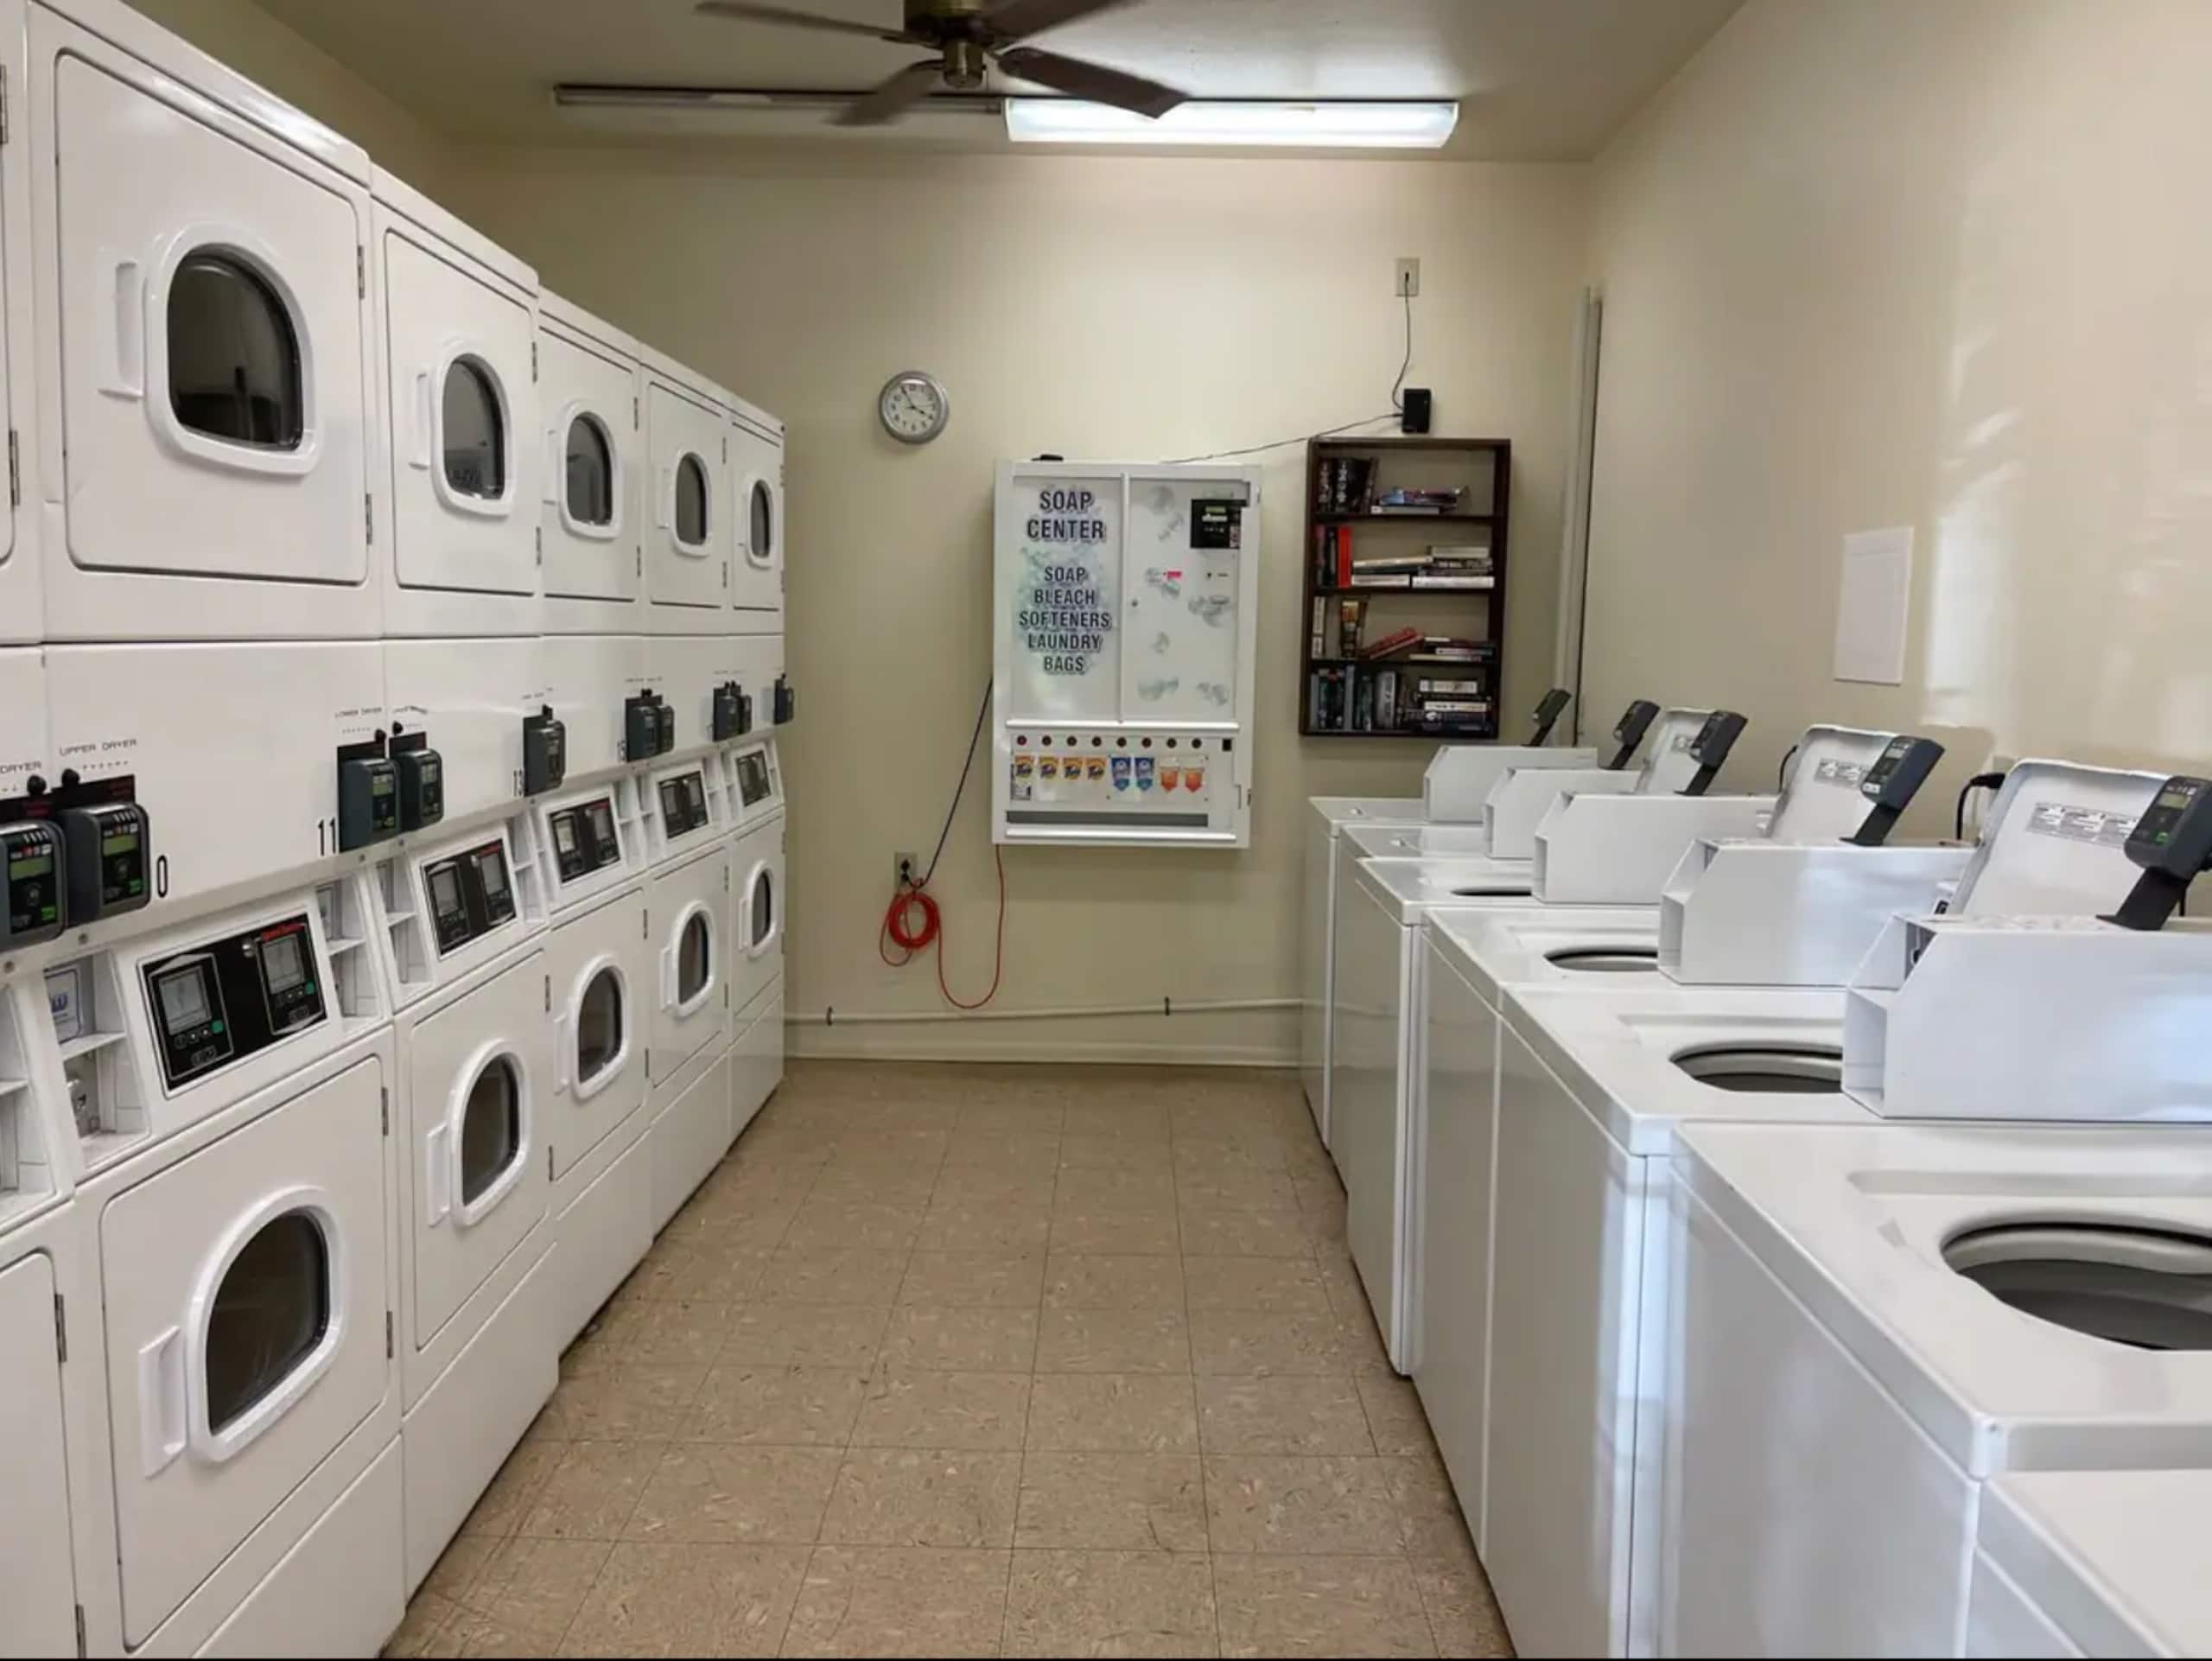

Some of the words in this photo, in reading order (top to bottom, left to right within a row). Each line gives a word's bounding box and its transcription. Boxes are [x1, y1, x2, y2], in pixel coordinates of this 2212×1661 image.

[1039, 490, 1093, 512] SOAP
[1027, 519, 1105, 540] CENTER
[1044, 566, 1087, 582] SOAP
[1034, 589, 1096, 606] BLEACH
[1019, 611, 1111, 628] SOFTENERS
[1027, 633, 1103, 650] LAUNDRY
[1044, 655, 1084, 672] BAGS
[59, 742, 97, 757] UPPER
[101, 737, 138, 752] DRYER
[317, 817, 337, 857] 11
